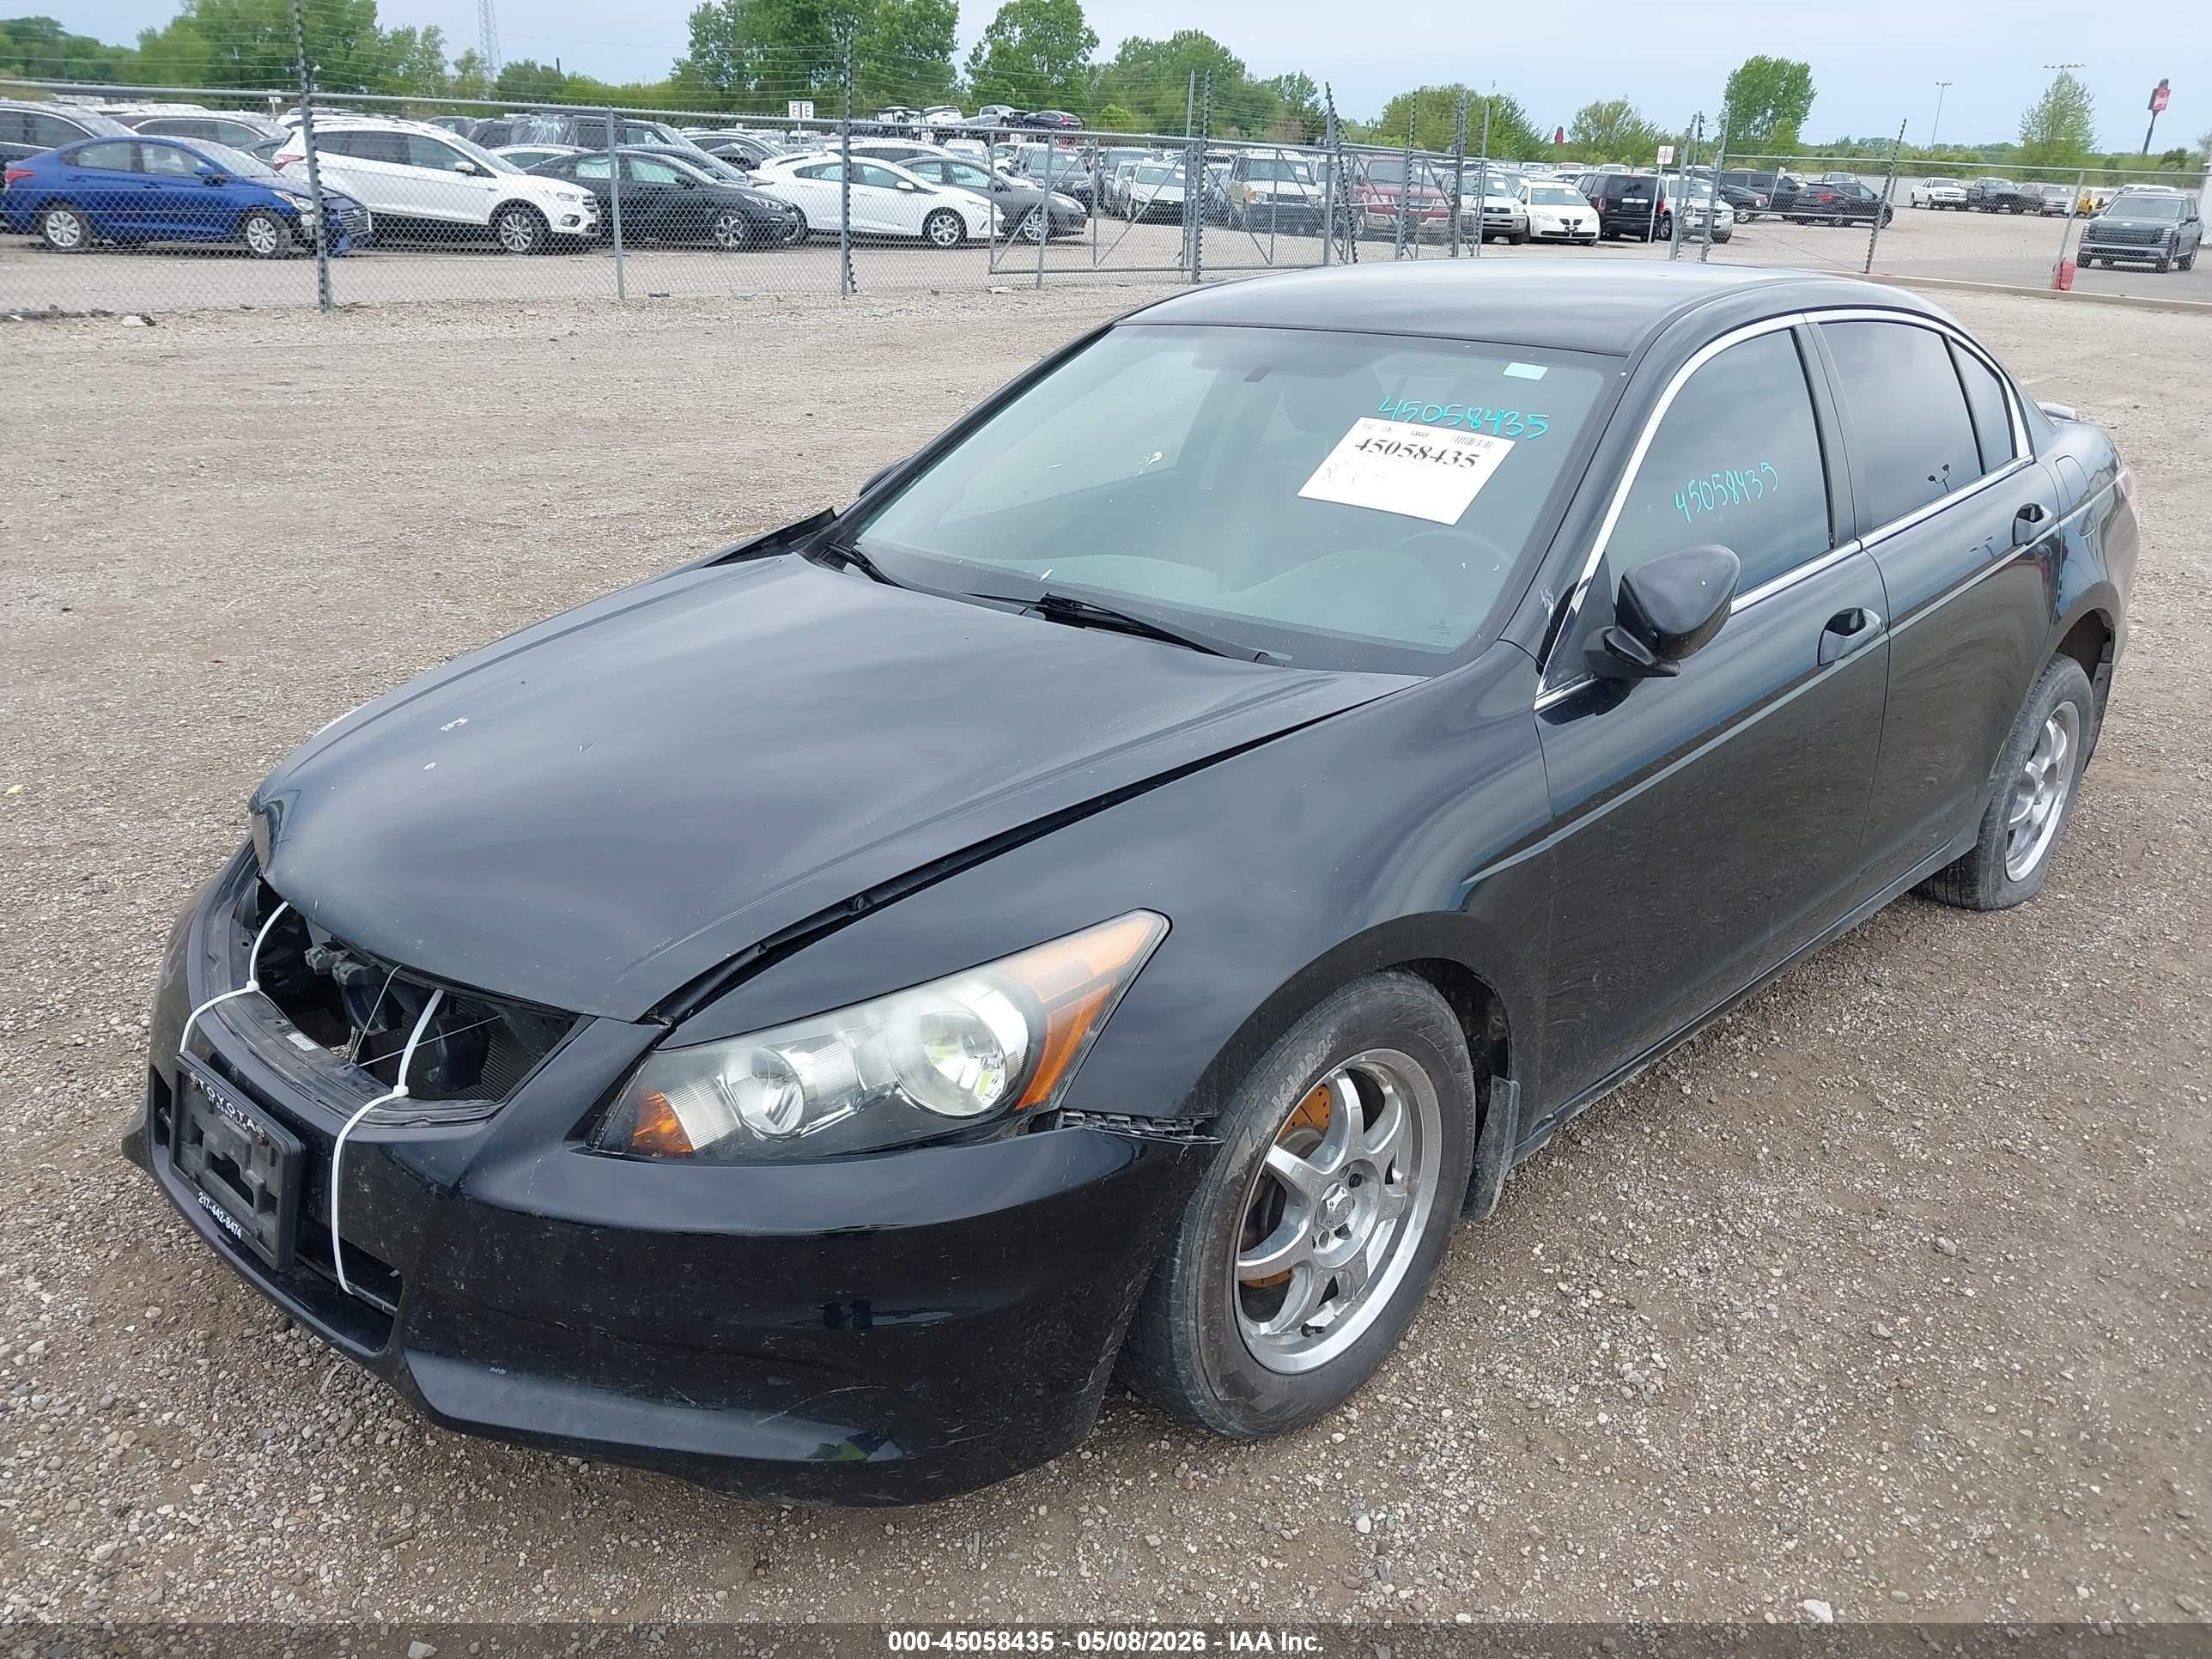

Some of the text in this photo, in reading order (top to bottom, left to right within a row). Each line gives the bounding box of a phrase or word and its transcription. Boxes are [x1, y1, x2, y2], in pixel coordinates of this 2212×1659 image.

[1378, 396, 1549, 440] 45058435
[1355, 438, 1480, 468] 45058435
[1675, 462, 1778, 522] 45058435
[197, 1078, 256, 1132] TOYOTA
[198, 1192, 241, 1239] 217-442-8474
